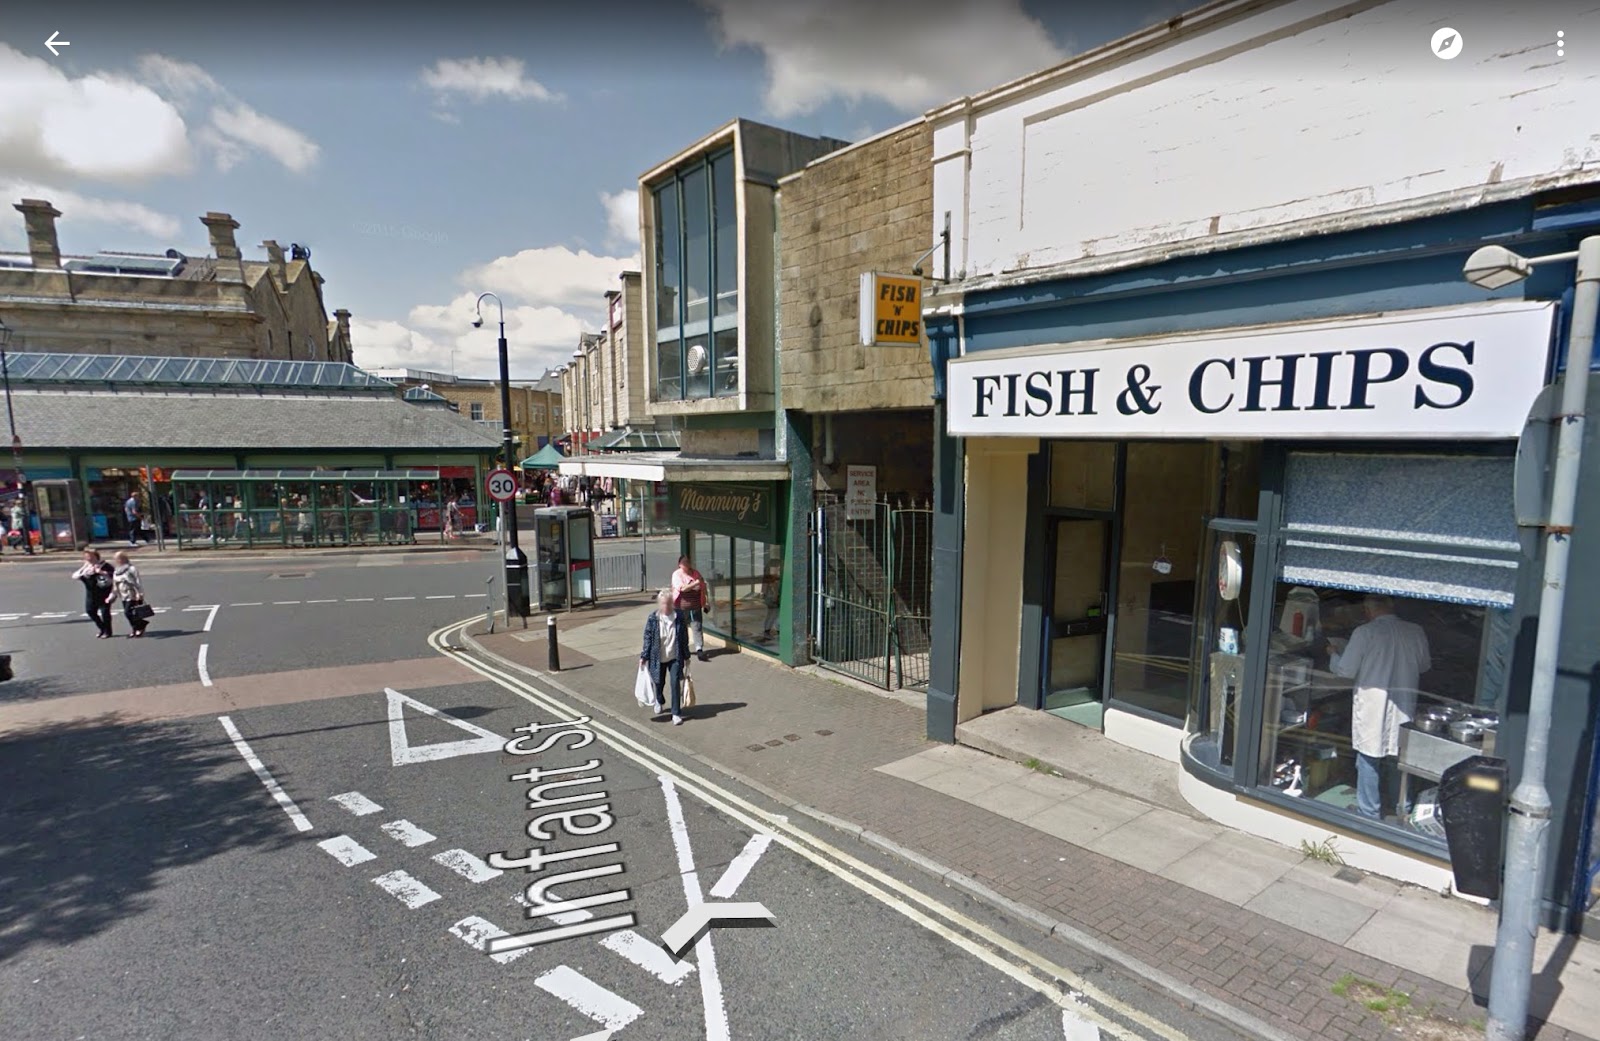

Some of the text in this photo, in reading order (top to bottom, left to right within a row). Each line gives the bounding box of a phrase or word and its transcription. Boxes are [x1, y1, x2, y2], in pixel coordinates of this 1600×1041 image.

[880, 283, 916, 303] FISH
[876, 319, 920, 337] CHIPS
[972, 340, 1476, 418] FISH & CHIPS
[491, 479, 514, 494] 30
[680, 487, 762, 521] Manning's
